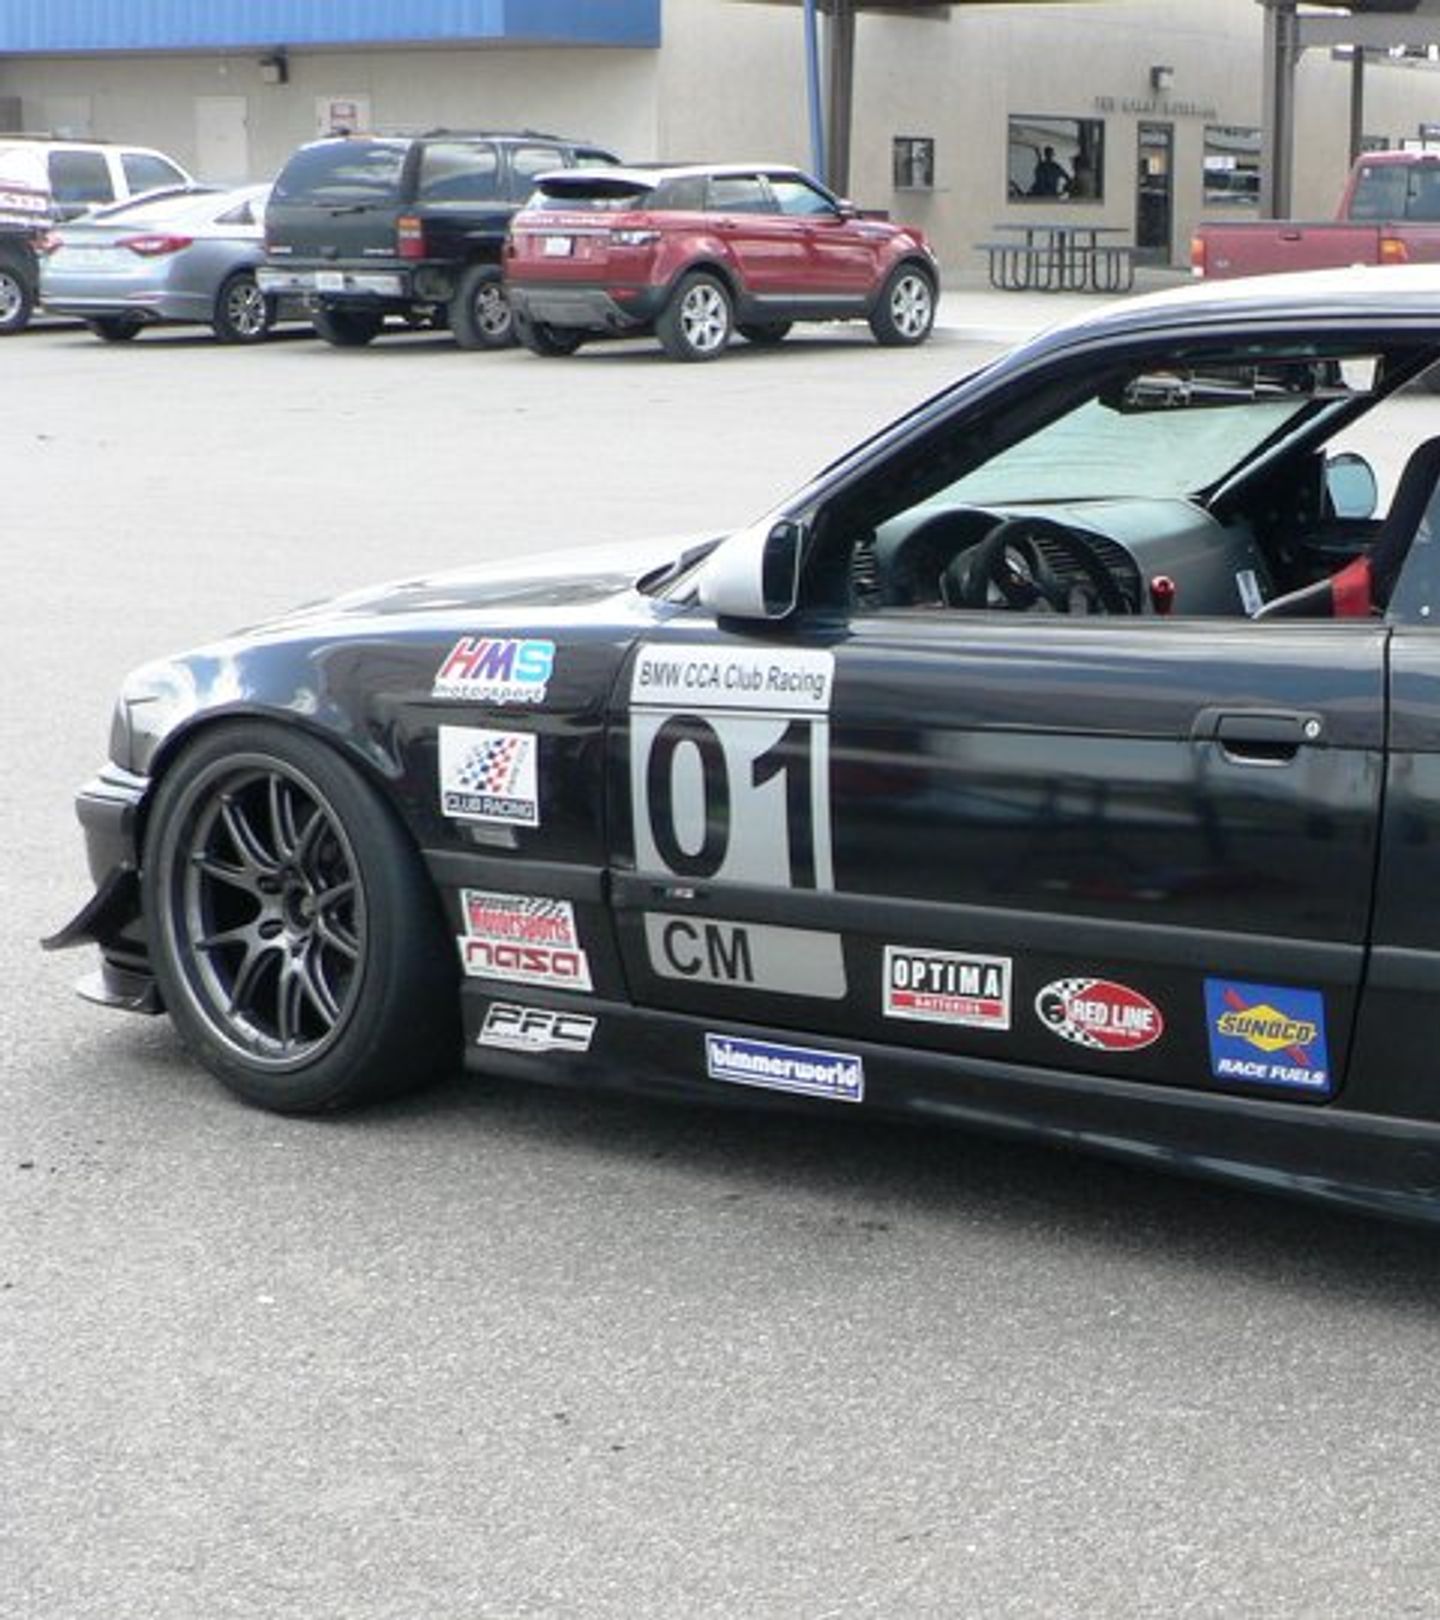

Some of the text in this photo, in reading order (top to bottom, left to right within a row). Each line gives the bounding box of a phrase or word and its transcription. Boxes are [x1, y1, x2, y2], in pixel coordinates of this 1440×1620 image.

[440, 640, 555, 682] HMS
[638, 661, 827, 700] BMW CCA Club Racing
[446, 794, 534, 819] CLUB RACING
[646, 714, 817, 890] 01
[662, 920, 755, 983] CM
[893, 958, 1000, 998] OPTIMA
[486, 1007, 593, 1042] PFC
[1072, 1000, 1109, 1025] RED
[1112, 1004, 1154, 1031] LINE
[1220, 1014, 1312, 1042] SUNOCO
[711, 1042, 857, 1088] bimmerworld
[1217, 1058, 1326, 1085] RACE FUELS
